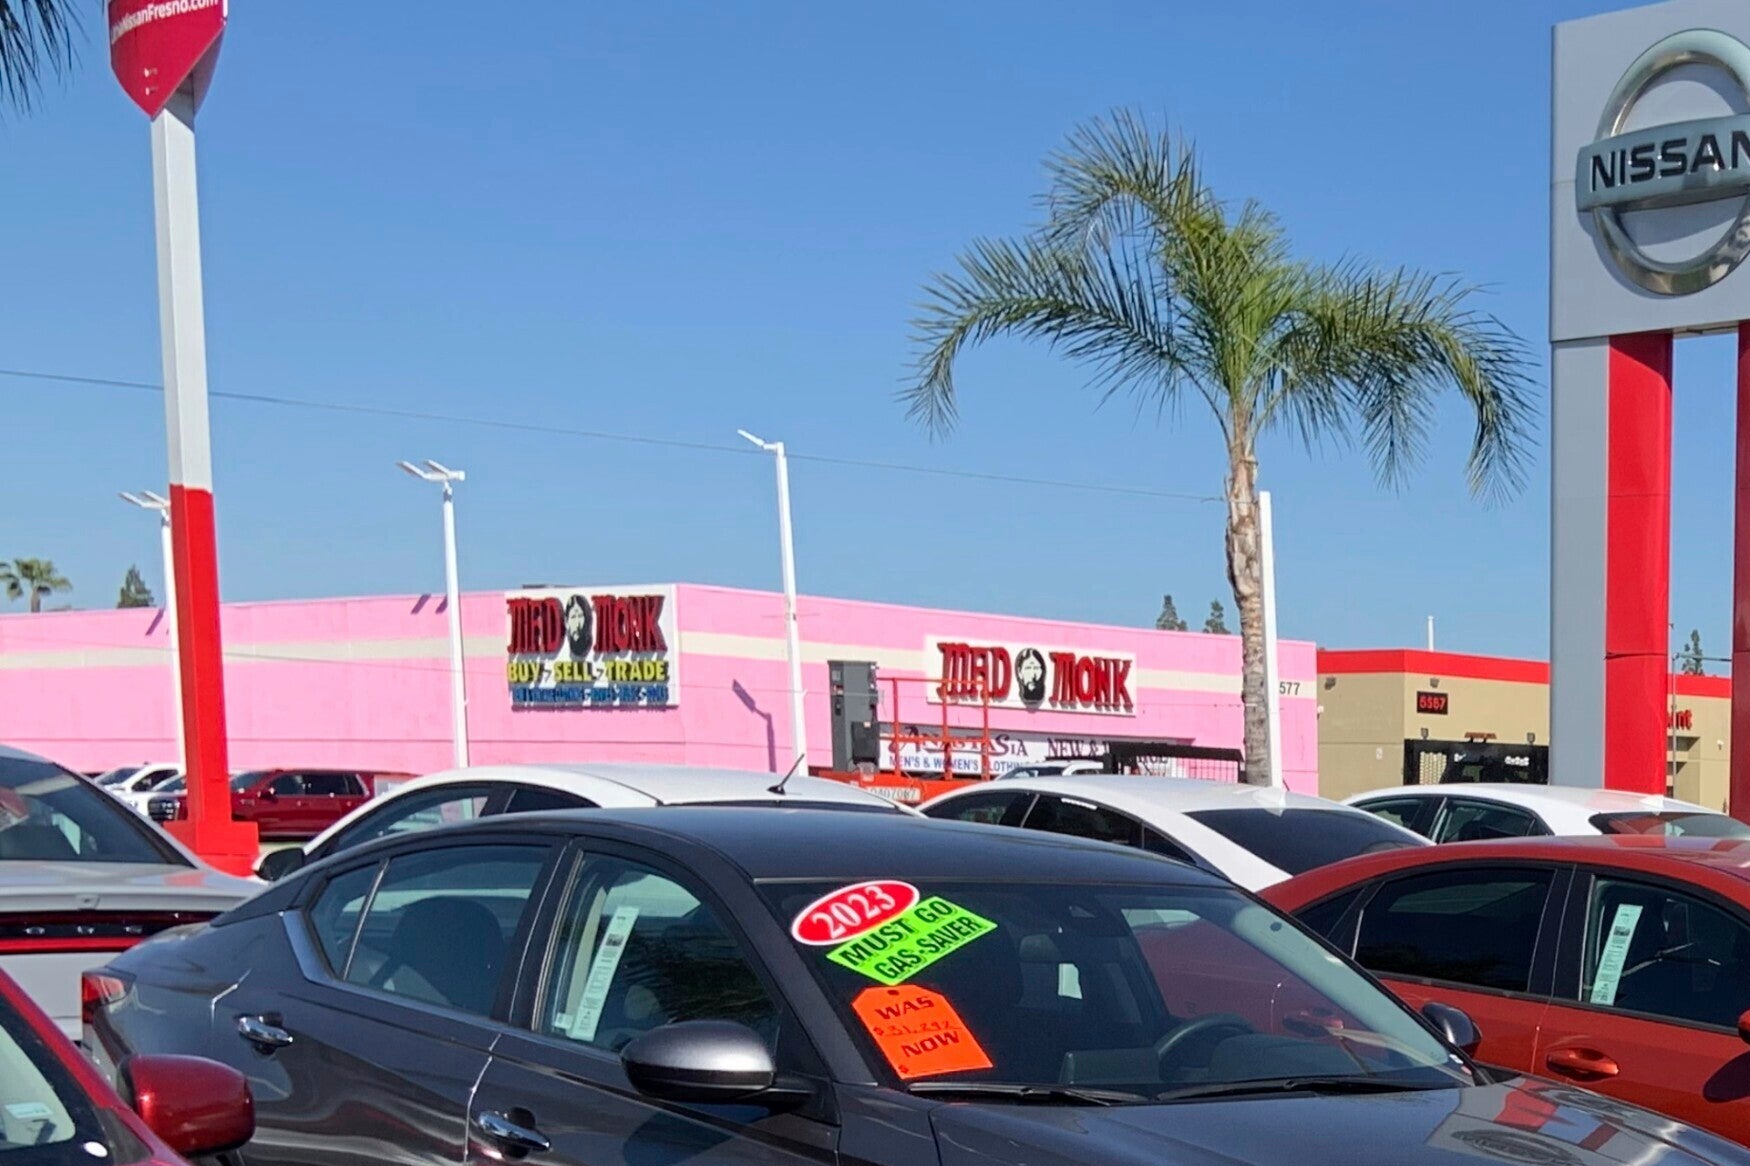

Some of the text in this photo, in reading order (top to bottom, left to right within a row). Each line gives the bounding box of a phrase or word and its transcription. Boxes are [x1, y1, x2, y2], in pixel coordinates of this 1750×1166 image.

[506, 594, 668, 654] MAD MONK
[604, 660, 666, 682] TRADE
[936, 642, 1134, 715] MAD MONK
[1047, 738, 1087, 757] NEW
[933, 756, 979, 771] WMEN'S
[812, 885, 897, 940] 2023
[840, 899, 954, 966] MUST GO
[874, 995, 935, 1020] WAS
[901, 1030, 960, 1058] NOW
